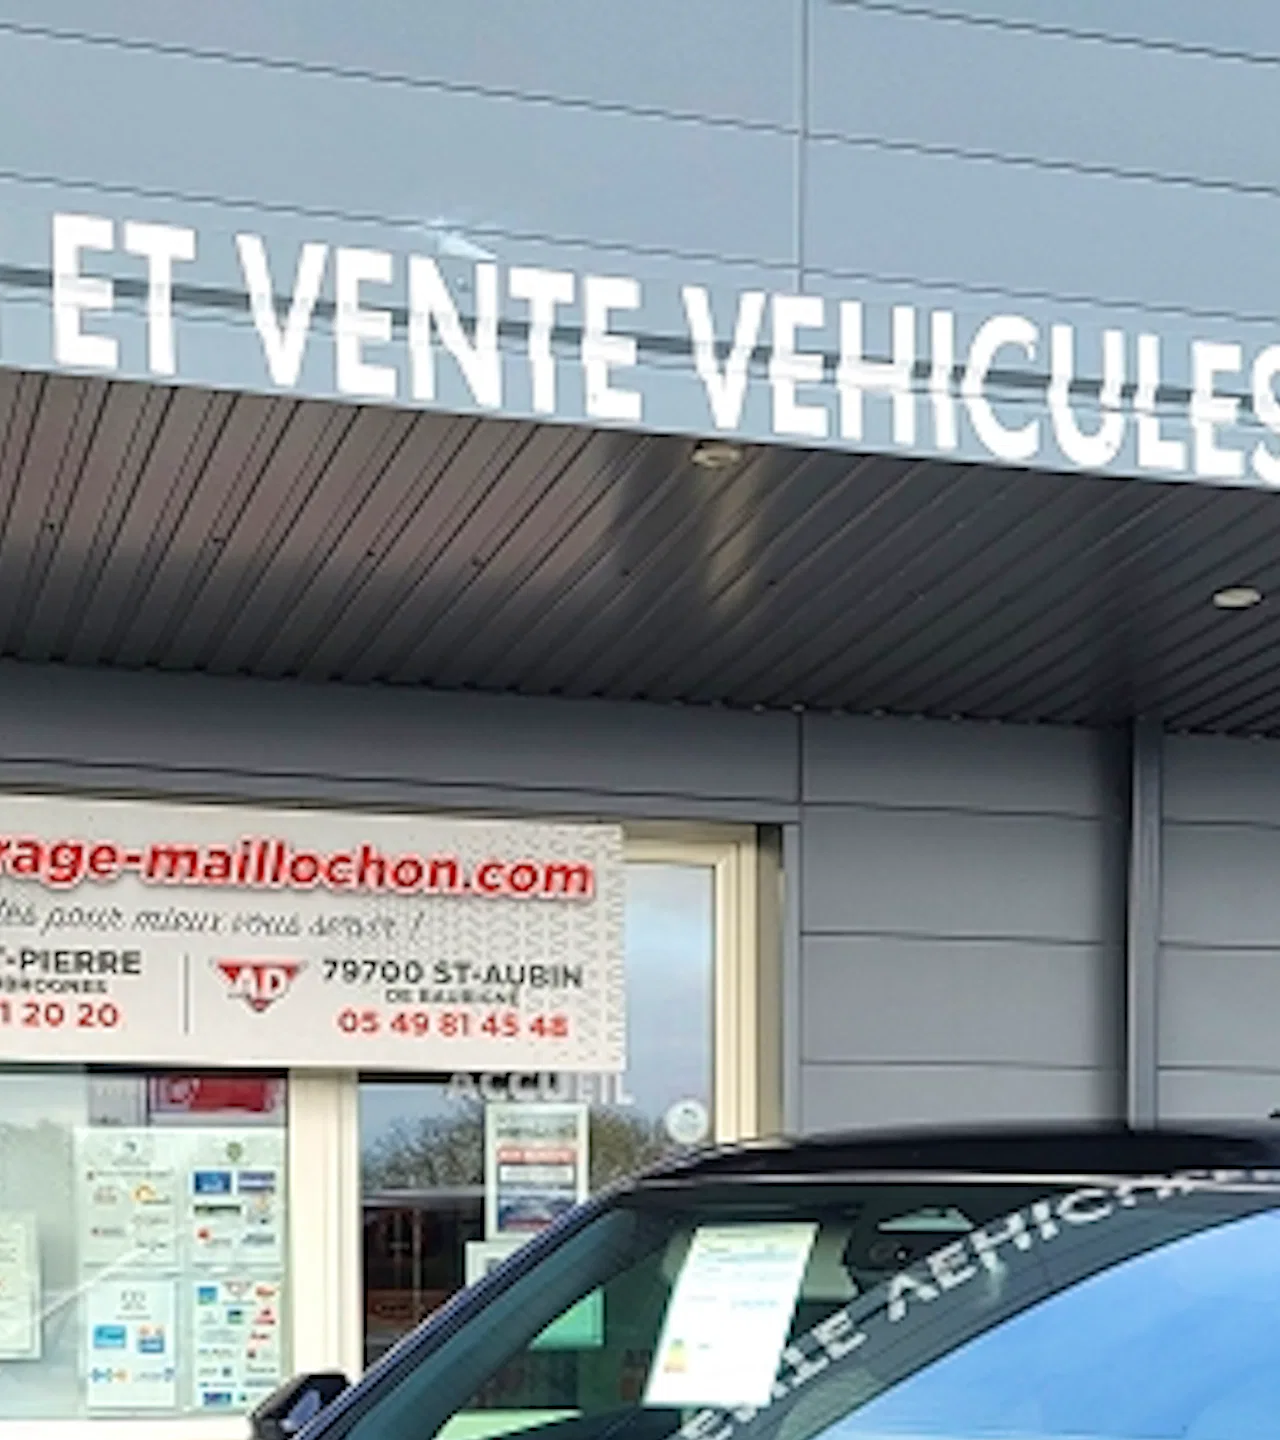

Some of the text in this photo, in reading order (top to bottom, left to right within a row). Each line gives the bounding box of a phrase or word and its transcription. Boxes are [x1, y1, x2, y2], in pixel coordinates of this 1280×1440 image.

[51, 212, 195, 376] ET
[234, 232, 645, 423] VENTE
[232, 965, 288, 1000] AD
[322, 959, 583, 988] 79700 ST-AUBIN
[22, 1002, 64, 1026] 20
[78, 1003, 120, 1027] 20
[338, 1010, 380, 1034] 05
[391, 1012, 429, 1036] 49
[439, 1012, 471, 1037] 81
